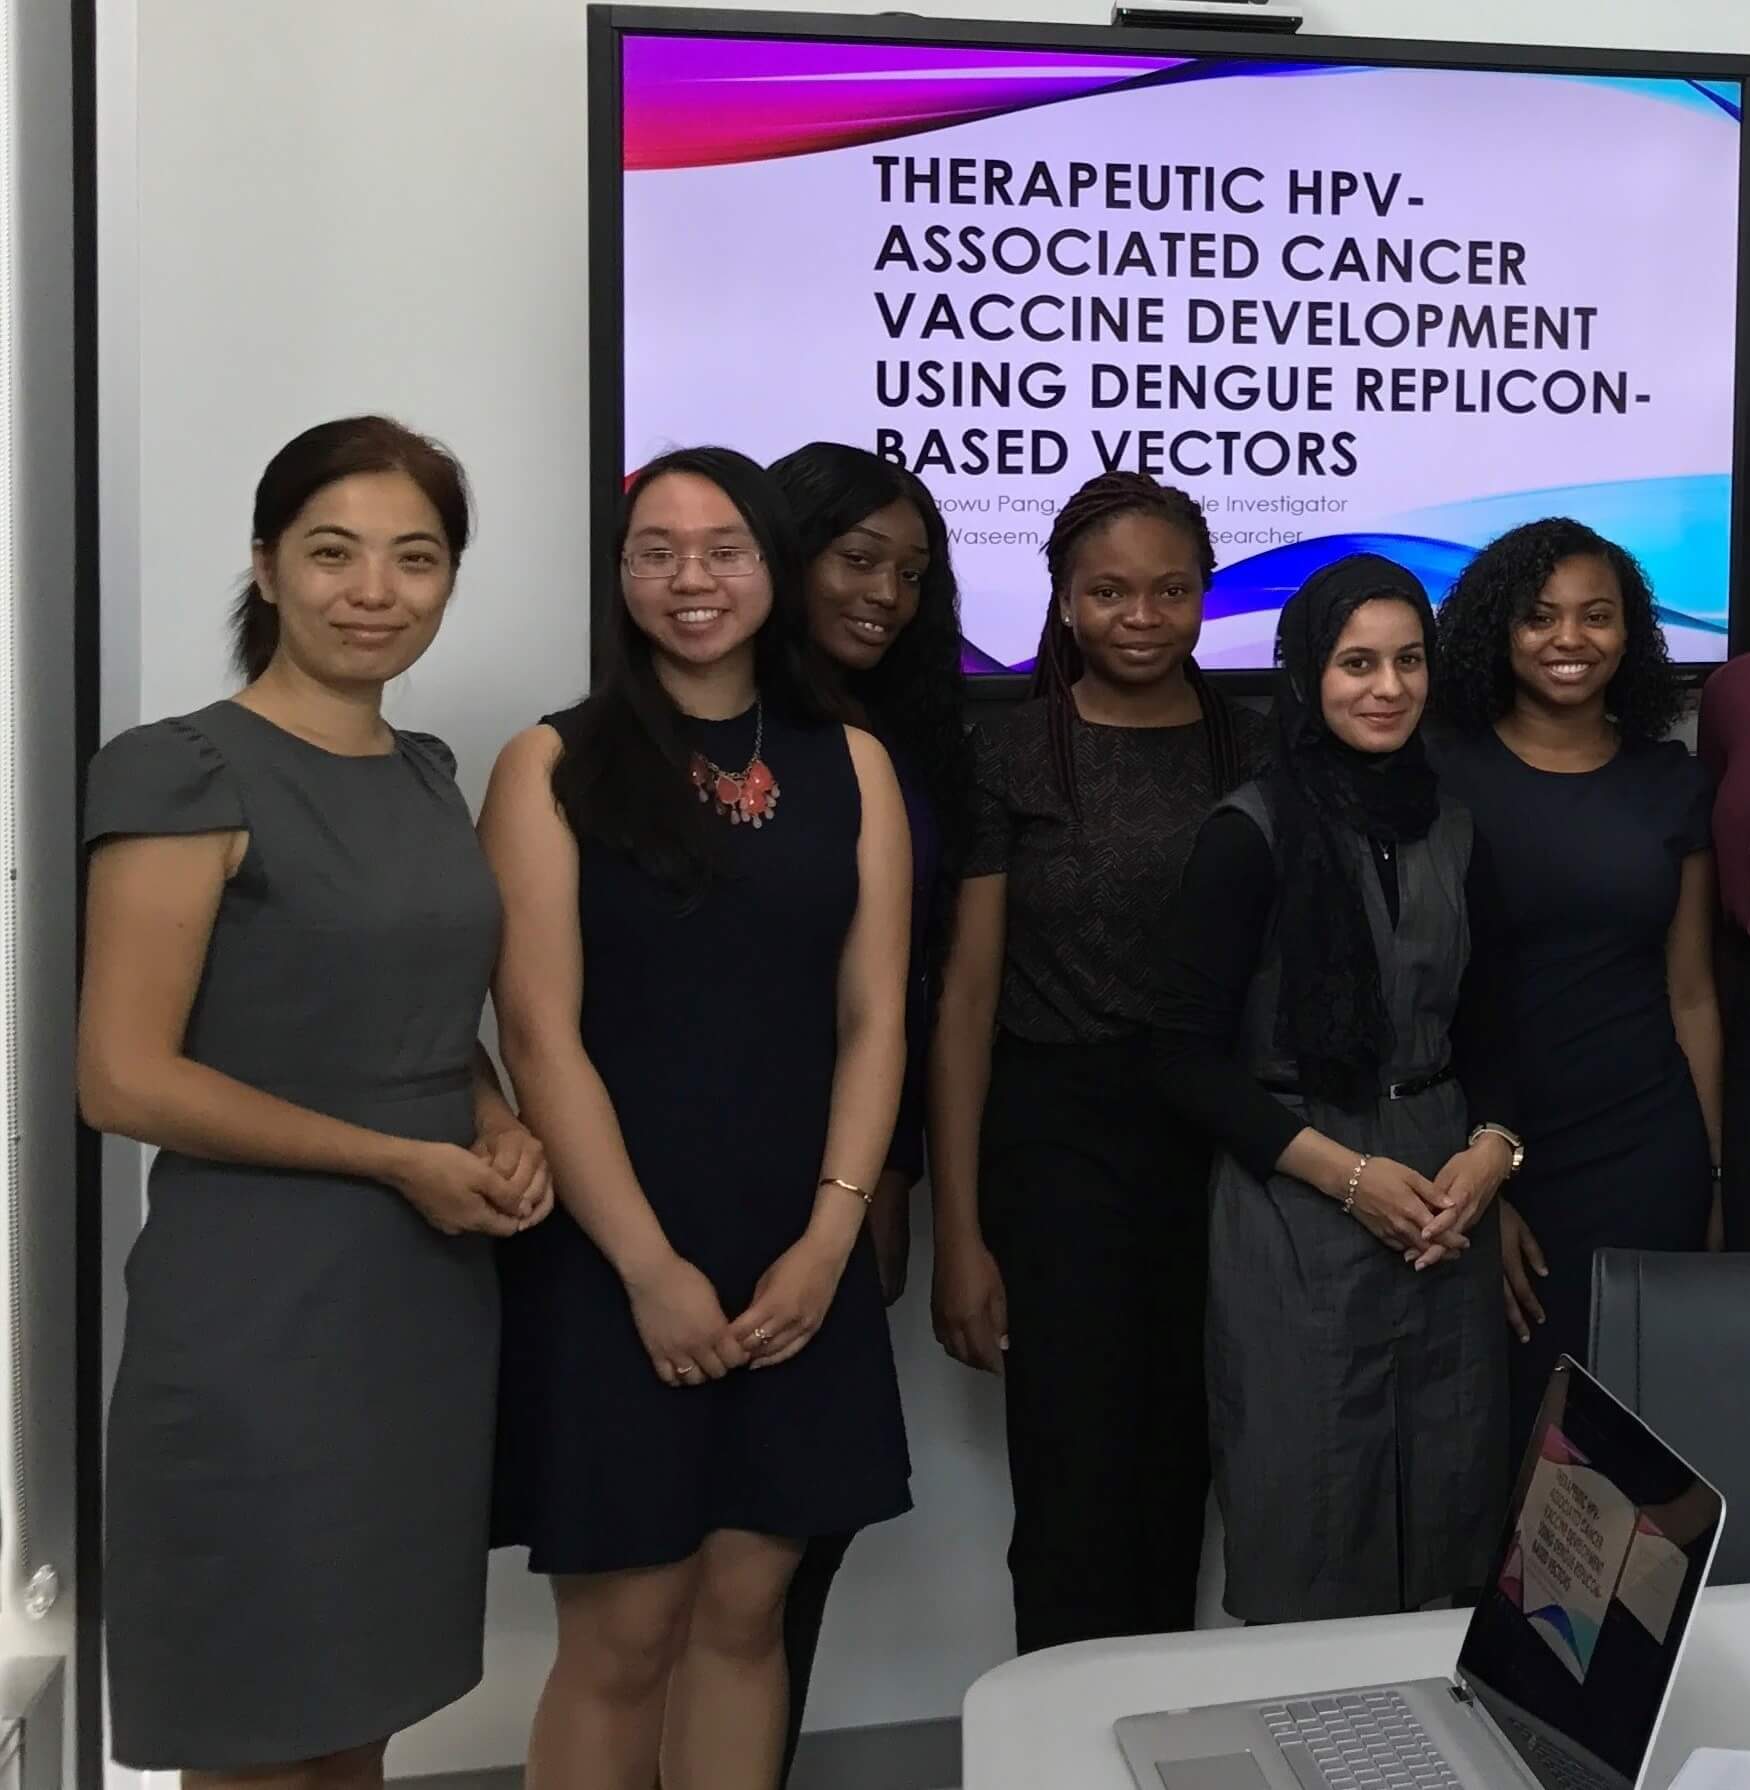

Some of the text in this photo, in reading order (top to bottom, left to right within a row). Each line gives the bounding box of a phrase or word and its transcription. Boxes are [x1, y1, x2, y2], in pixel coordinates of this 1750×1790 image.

[872, 155, 1424, 217] THERAPEUTIC HPV-
[874, 224, 1526, 286] ASSOCIATED CANCER
[874, 292, 1598, 350] VACCINE DEVELOPMENT
[876, 360, 1651, 415] USING DENGUE REPLICON-
[876, 428, 1357, 477] BASED VECTORS
[935, 497, 991, 513] aowu
[1226, 495, 1349, 517] Investigator
[1208, 528, 1304, 544] searcher
